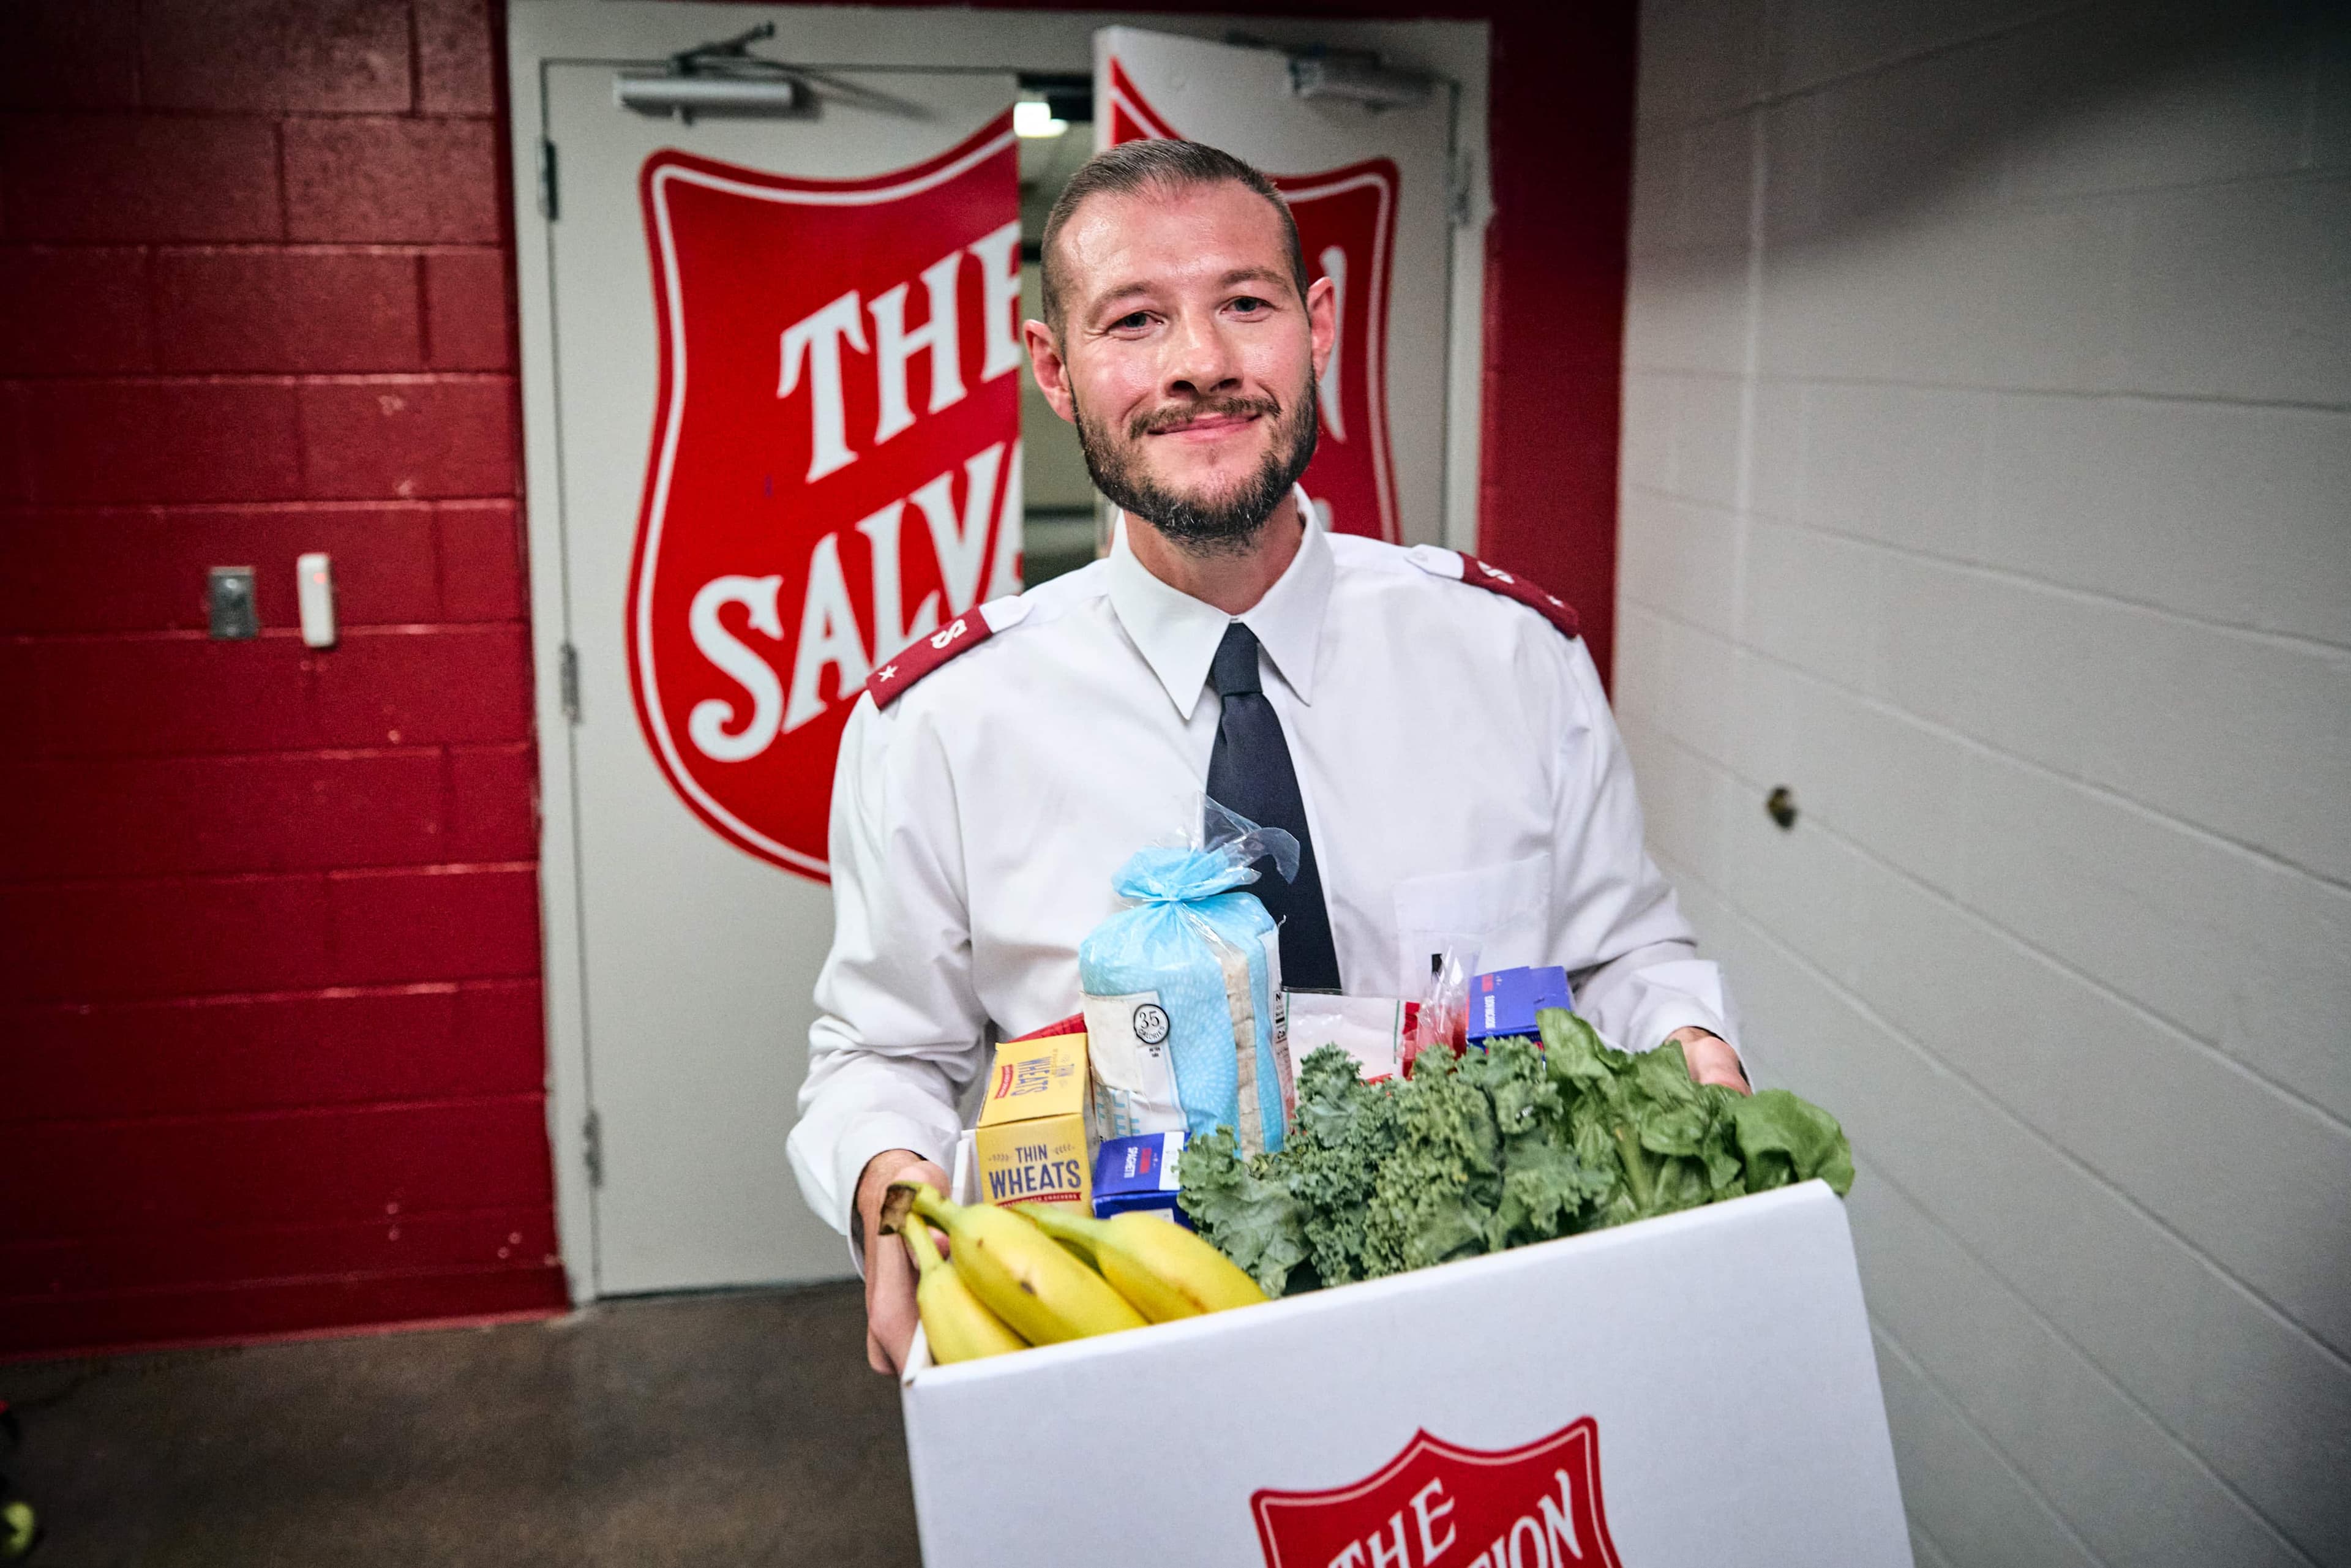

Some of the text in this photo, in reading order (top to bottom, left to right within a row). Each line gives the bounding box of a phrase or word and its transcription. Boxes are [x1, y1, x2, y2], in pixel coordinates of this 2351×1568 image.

[776, 219, 1021, 484] THE
[1139, 1011, 1160, 1029] 35
[1010, 1056, 1054, 1097] WHEATS
[1015, 1144, 1048, 1163] THIN
[988, 1159, 1082, 1200] WHEATS
